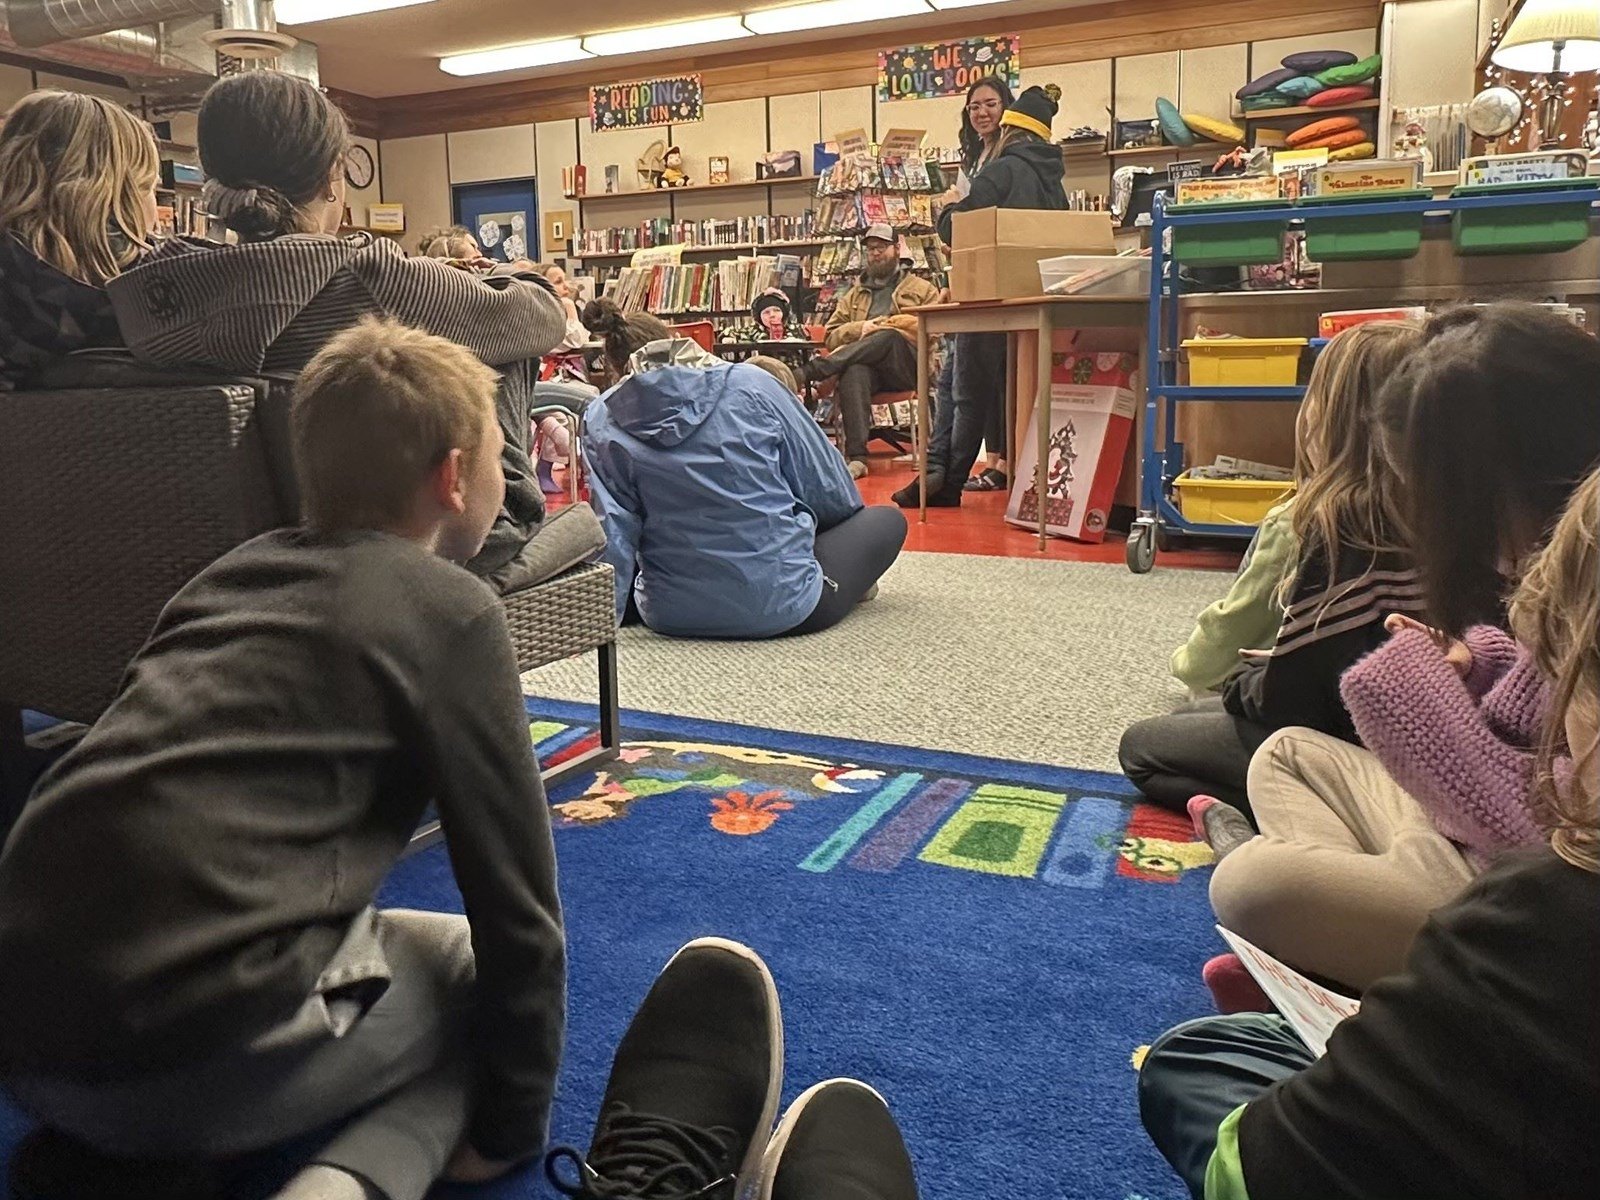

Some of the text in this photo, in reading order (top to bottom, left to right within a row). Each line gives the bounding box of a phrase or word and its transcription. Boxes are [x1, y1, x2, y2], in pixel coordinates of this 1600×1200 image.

[933, 46, 963, 70] WE
[891, 71, 935, 95] LOVE
[610, 82, 683, 110] READING
[625, 105, 670, 124] IS FUN
